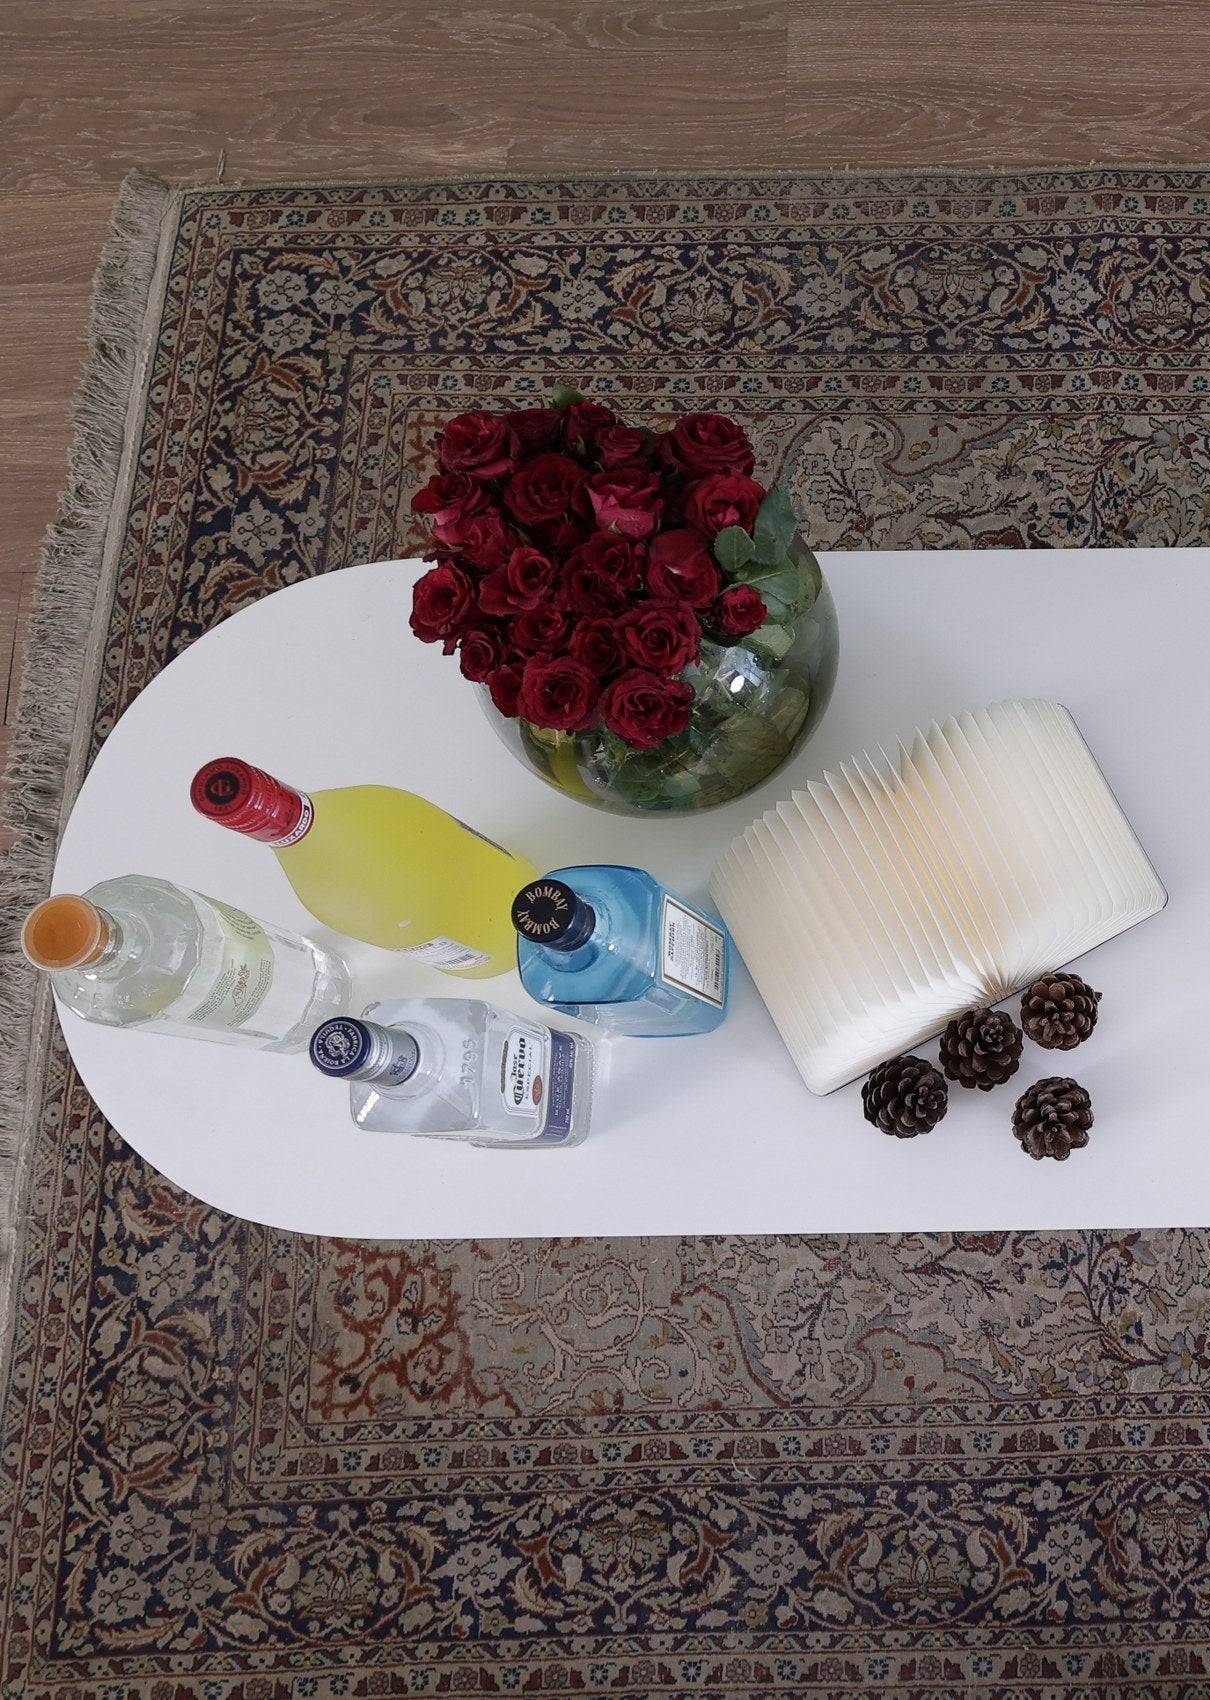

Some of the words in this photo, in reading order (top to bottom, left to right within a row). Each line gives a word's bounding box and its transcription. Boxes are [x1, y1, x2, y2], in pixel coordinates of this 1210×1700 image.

[275, 809, 310, 846] LUXARDO
[525, 886, 568, 911] BOMBAY
[517, 909, 559, 935] BOMBAY
[318, 1024, 344, 1044] TEQUILA
[347, 1028, 359, 1056] FABRICA
[513, 1037, 526, 1105] Cuervo
